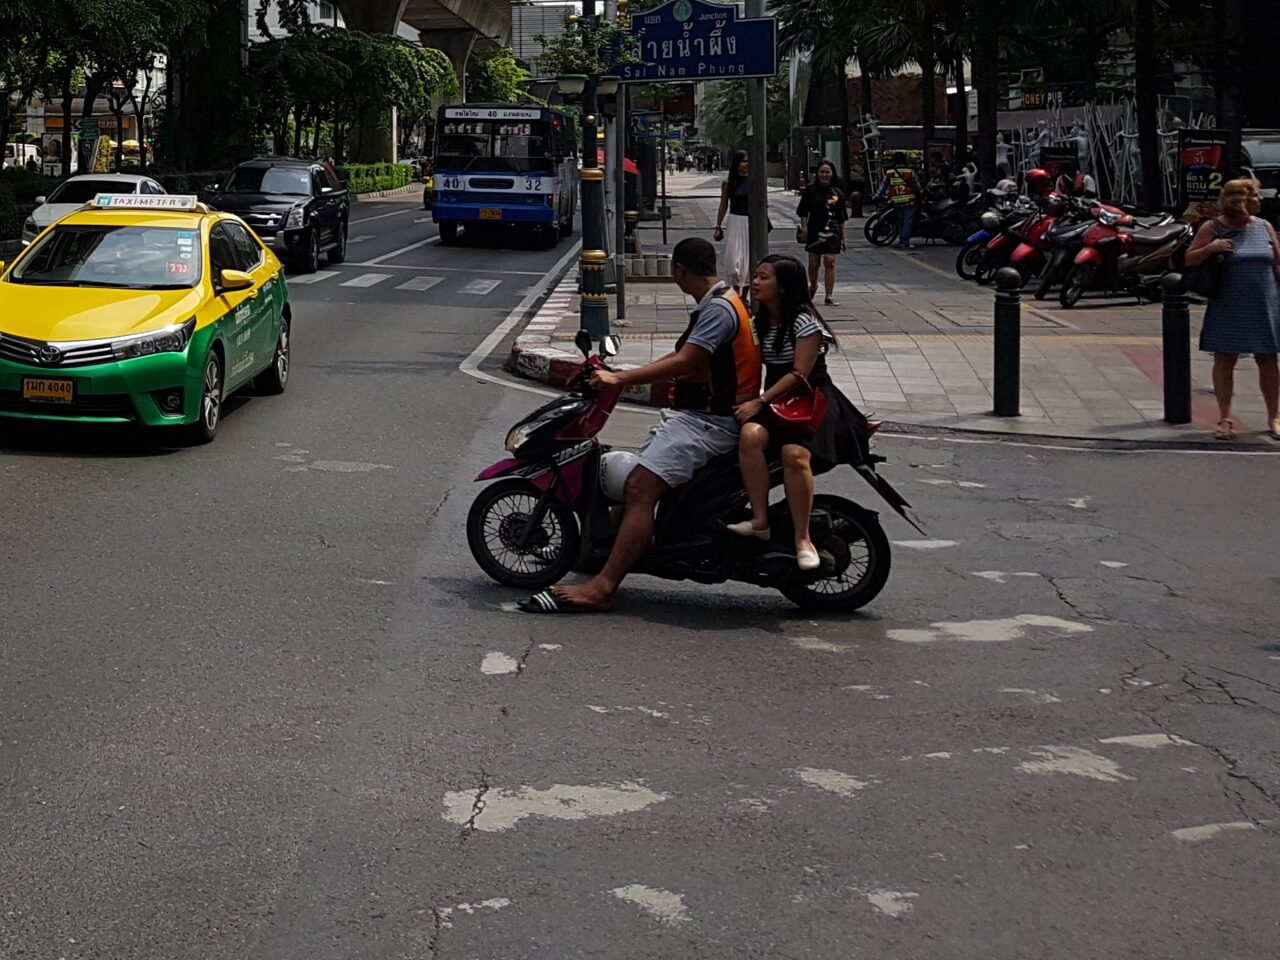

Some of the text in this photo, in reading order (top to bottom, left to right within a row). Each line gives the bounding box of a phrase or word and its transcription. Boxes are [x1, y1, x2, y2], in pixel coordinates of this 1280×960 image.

[644, 15, 661, 24] แยก
[699, 12, 727, 21] Junction
[631, 21, 736, 59] สายน้ำผึ้ง
[624, 62, 745, 78] Sai Nam Phung
[443, 178, 541, 190] 40 32
[1209, 172, 1223, 190] 2
[895, 185, 906, 195] 12
[26, 381, 71, 393] 1มก 4040
